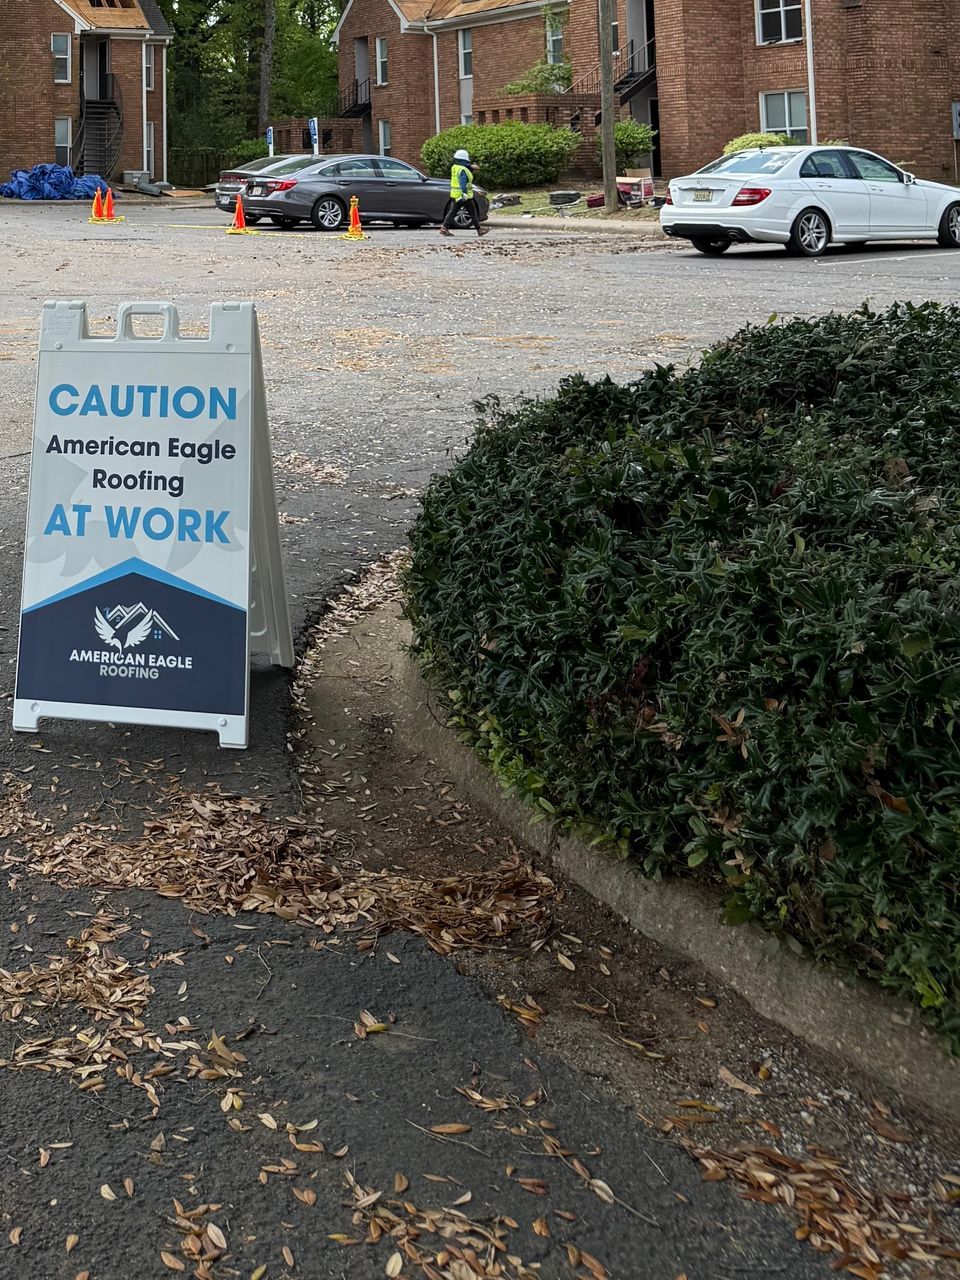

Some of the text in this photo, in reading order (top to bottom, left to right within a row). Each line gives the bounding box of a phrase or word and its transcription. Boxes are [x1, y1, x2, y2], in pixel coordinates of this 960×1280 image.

[49, 383, 237, 420] CAUTION
[46, 434, 237, 465] American Eagle
[92, 468, 184, 497] Roofing
[43, 503, 231, 544] AT WORK
[69, 649, 193, 669] AMERICAN EAGLE
[100, 664, 159, 679] ROOFING
